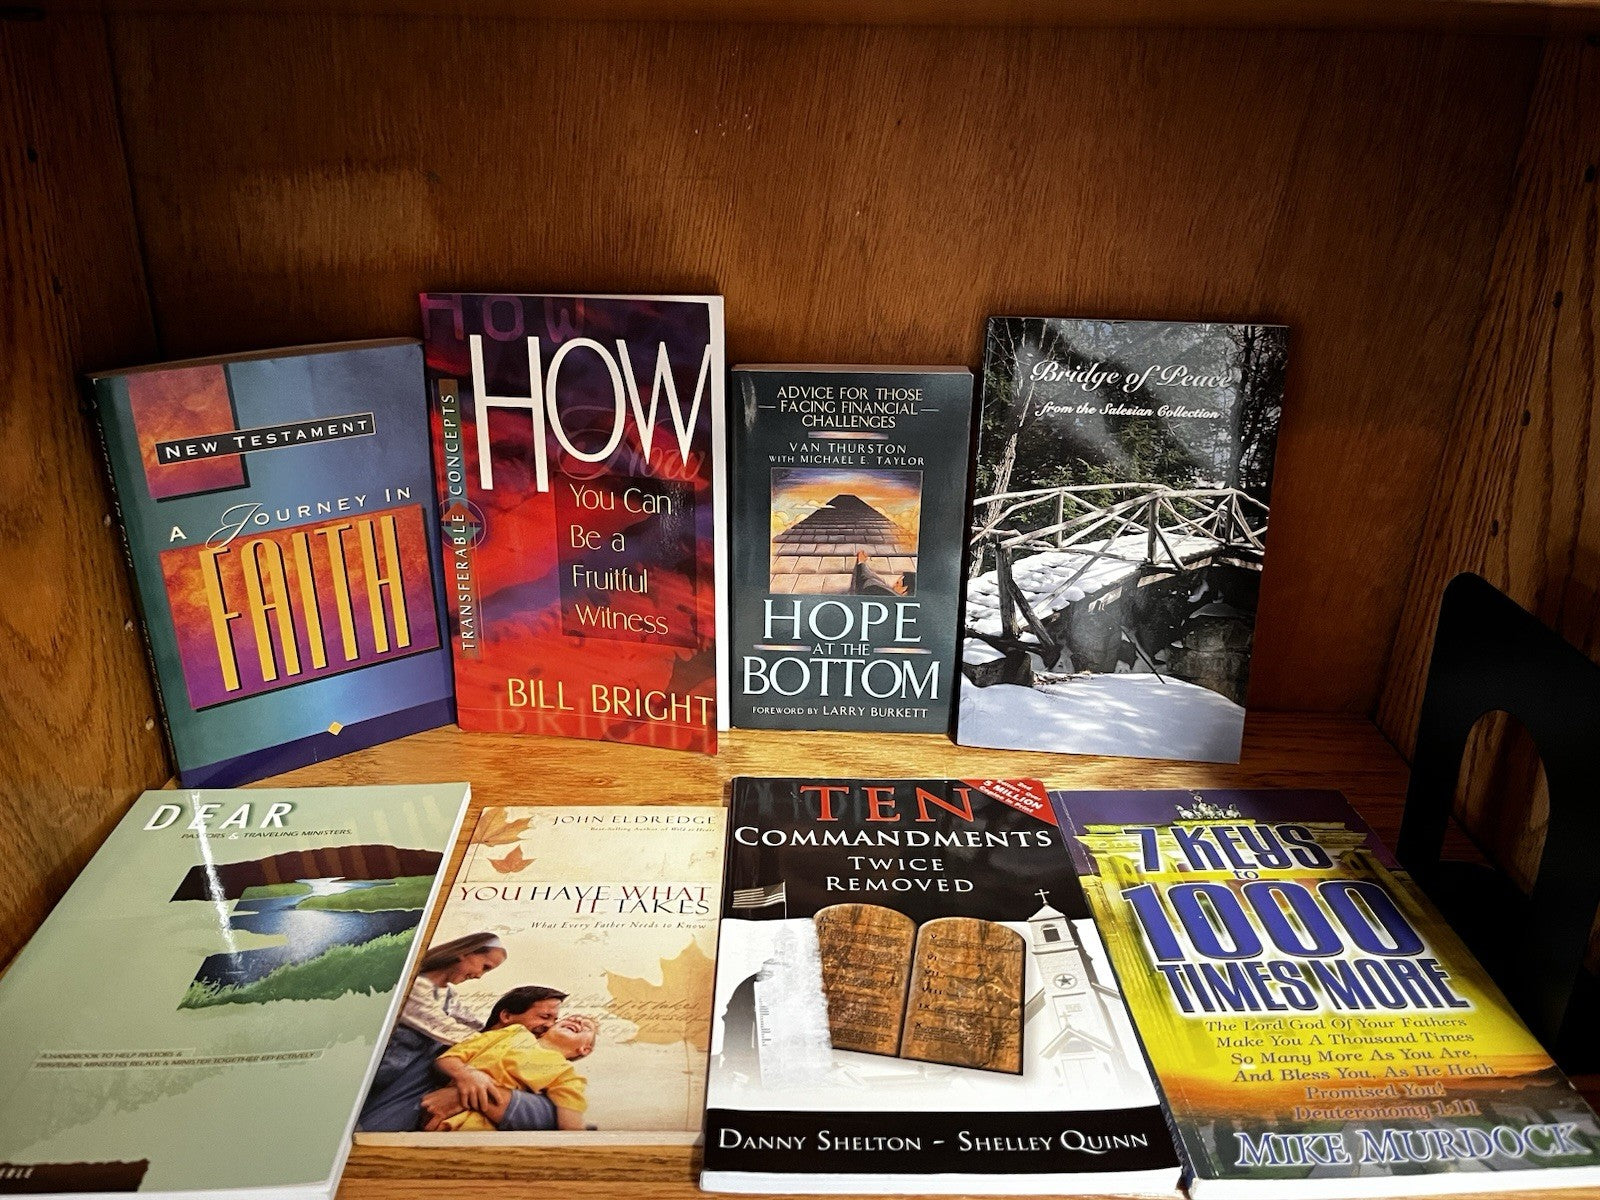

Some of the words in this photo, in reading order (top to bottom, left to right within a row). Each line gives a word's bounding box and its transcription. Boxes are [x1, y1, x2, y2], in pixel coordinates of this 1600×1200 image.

[1029, 359, 1121, 392] Bridge
[1124, 364, 1161, 393] of
[1156, 364, 1234, 388] Peace
[776, 386, 834, 400] ADVICE
[839, 386, 869, 400] FOR
[875, 387, 924, 401] THOSE
[469, 333, 712, 493] HOW
[780, 400, 836, 414] FACING
[841, 401, 918, 416] FINANCIAL
[1034, 400, 1073, 417] from
[1076, 402, 1097, 415] the
[1099, 403, 1154, 417] Salesian
[1157, 404, 1221, 420] Collection
[801, 414, 896, 429] CHALLENGES
[164, 437, 220, 460] NEW
[232, 418, 370, 449] TESTAMENT
[440, 394, 463, 496] CONCEPTS
[789, 441, 821, 453] VAN
[828, 442, 907, 455] THURSTON
[768, 455, 795, 464] WITH
[800, 454, 854, 466] MICHAEL
[860, 456, 870, 466] E.
[876, 456, 925, 467] TAYLOR
[568, 483, 616, 511] You
[623, 487, 673, 515] Can
[169, 525, 188, 542] A
[205, 493, 368, 551] JOURNEY
[384, 486, 412, 503] IN
[570, 523, 602, 551] Be
[611, 531, 626, 552] a
[451, 513, 475, 651] TRANSFERABLE
[571, 563, 649, 595] Fruitful
[200, 514, 411, 693] FAITH
[574, 603, 670, 636] Witness
[762, 600, 922, 643] HOPE
[812, 643, 833, 656] AT
[840, 643, 871, 656] THE
[742, 656, 941, 701] BOTTOM
[507, 676, 575, 711] BILL
[590, 683, 715, 727] BRIGHT
[752, 706, 805, 716] FOREWORD
[807, 707, 819, 715] BY
[823, 705, 866, 717] LARRY
[870, 707, 929, 719] BURKETT
[799, 785, 976, 823] TEN
[992, 784, 1044, 810] MILLION
[142, 802, 294, 832] DEAR
[553, 814, 605, 827] JOHN
[612, 814, 718, 826] ELDREDGE
[181, 832, 227, 840] PASORS
[227, 832, 239, 840] &
[243, 830, 299, 839] TRAVELING
[734, 826, 1053, 848] COMMANDMENTS
[1123, 827, 1164, 873] 7
[1170, 824, 1336, 871] KEYS
[847, 856, 946, 872] TWICE
[1232, 869, 1259, 880] to
[460, 886, 523, 901] YOU
[529, 885, 611, 901] HAVE
[620, 886, 713, 901] WHAT
[825, 877, 975, 893] REMOVED
[574, 899, 610, 914] IT
[613, 899, 710, 915] TAKES
[531, 921, 558, 930] What
[561, 921, 591, 931] Every
[593, 920, 626, 930] Father
[629, 921, 659, 929] Needs
[676, 922, 708, 930] Know
[1121, 880, 1427, 962] 1000
[1157, 959, 1320, 1013] TIMES
[1315, 957, 1473, 1010] MORE
[1205, 1020, 1238, 1032] The
[1244, 1019, 1284, 1032] Lord
[1288, 1019, 1326, 1032] God
[1330, 1018, 1353, 1032] Of
[1357, 1017, 1396, 1030] Your
[1402, 1017, 1468, 1029] Fathers
[1216, 1035, 1264, 1049] Make
[1268, 1035, 1305, 1048] You
[1308, 1034, 1324, 1046] A
[1328, 1032, 1416, 1045] Thousand
[1420, 1031, 1475, 1044] Times
[1231, 1052, 1255, 1066] So
[1260, 1050, 1312, 1067] Many
[1317, 1049, 1365, 1063] More
[1371, 1048, 1396, 1061] As
[1400, 1047, 1437, 1060] You
[1440, 1046, 1479, 1060] Are,
[1232, 1069, 1273, 1083] And
[1279, 1067, 1331, 1081] Bless
[1383, 1065, 1410, 1079] As
[1415, 1064, 1443, 1077] He
[1446, 1062, 1498, 1077] Hath
[1305, 1085, 1399, 1101] Promised
[1402, 1082, 1447, 1098] You!
[1292, 1103, 1432, 1122] Deuteronomy
[1434, 1099, 1483, 1117] 1:11
[719, 1127, 807, 1151] DANNY
[816, 1129, 922, 1152] SHELTON
[959, 1130, 1054, 1153] SHELLEY
[1059, 1128, 1149, 1155] QUINN
[1233, 1129, 1352, 1167] MIKE
[1352, 1122, 1592, 1167] MURDOCK
